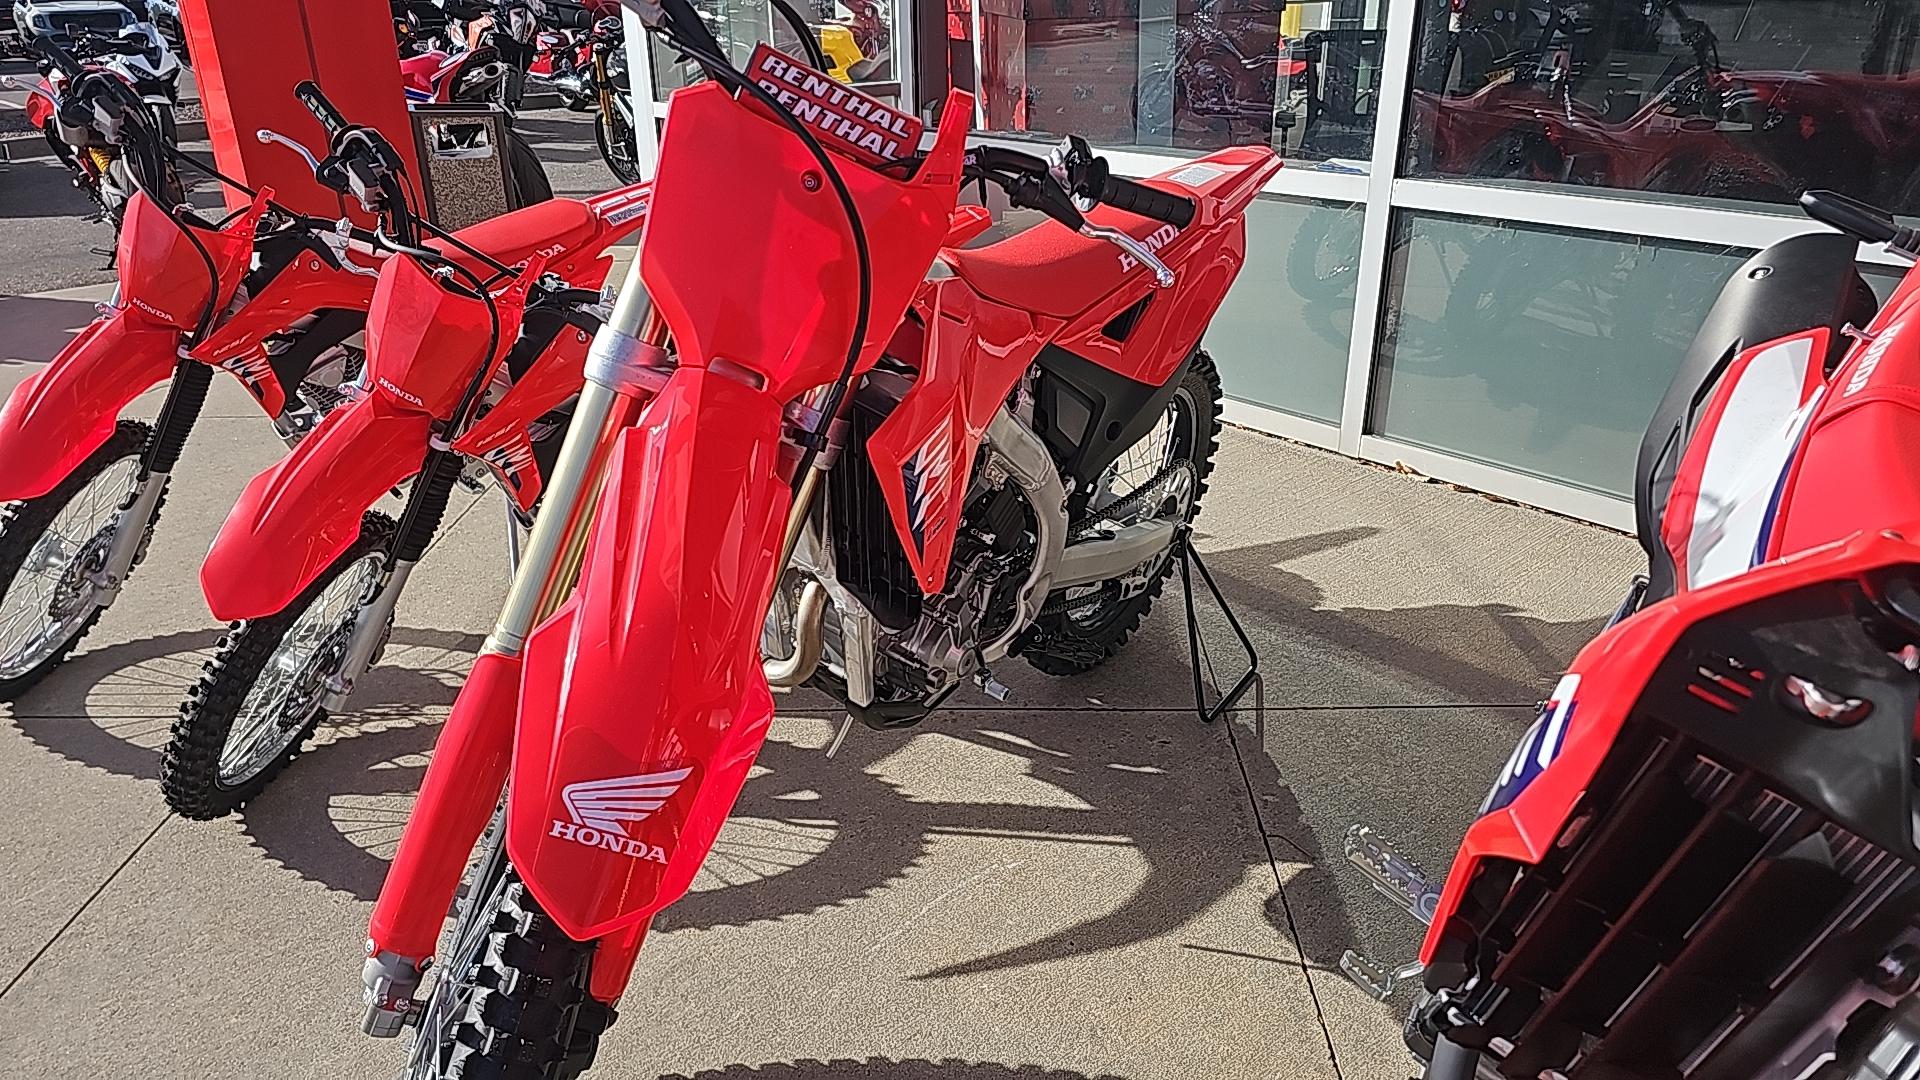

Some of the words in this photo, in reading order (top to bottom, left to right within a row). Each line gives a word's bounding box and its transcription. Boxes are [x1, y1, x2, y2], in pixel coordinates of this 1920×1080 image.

[761, 55, 909, 139] RENTHAL
[132, 296, 174, 322] HONDA
[1842, 320, 1906, 398] HONDA
[378, 376, 424, 407] HONDA
[548, 819, 669, 865] HONDA
